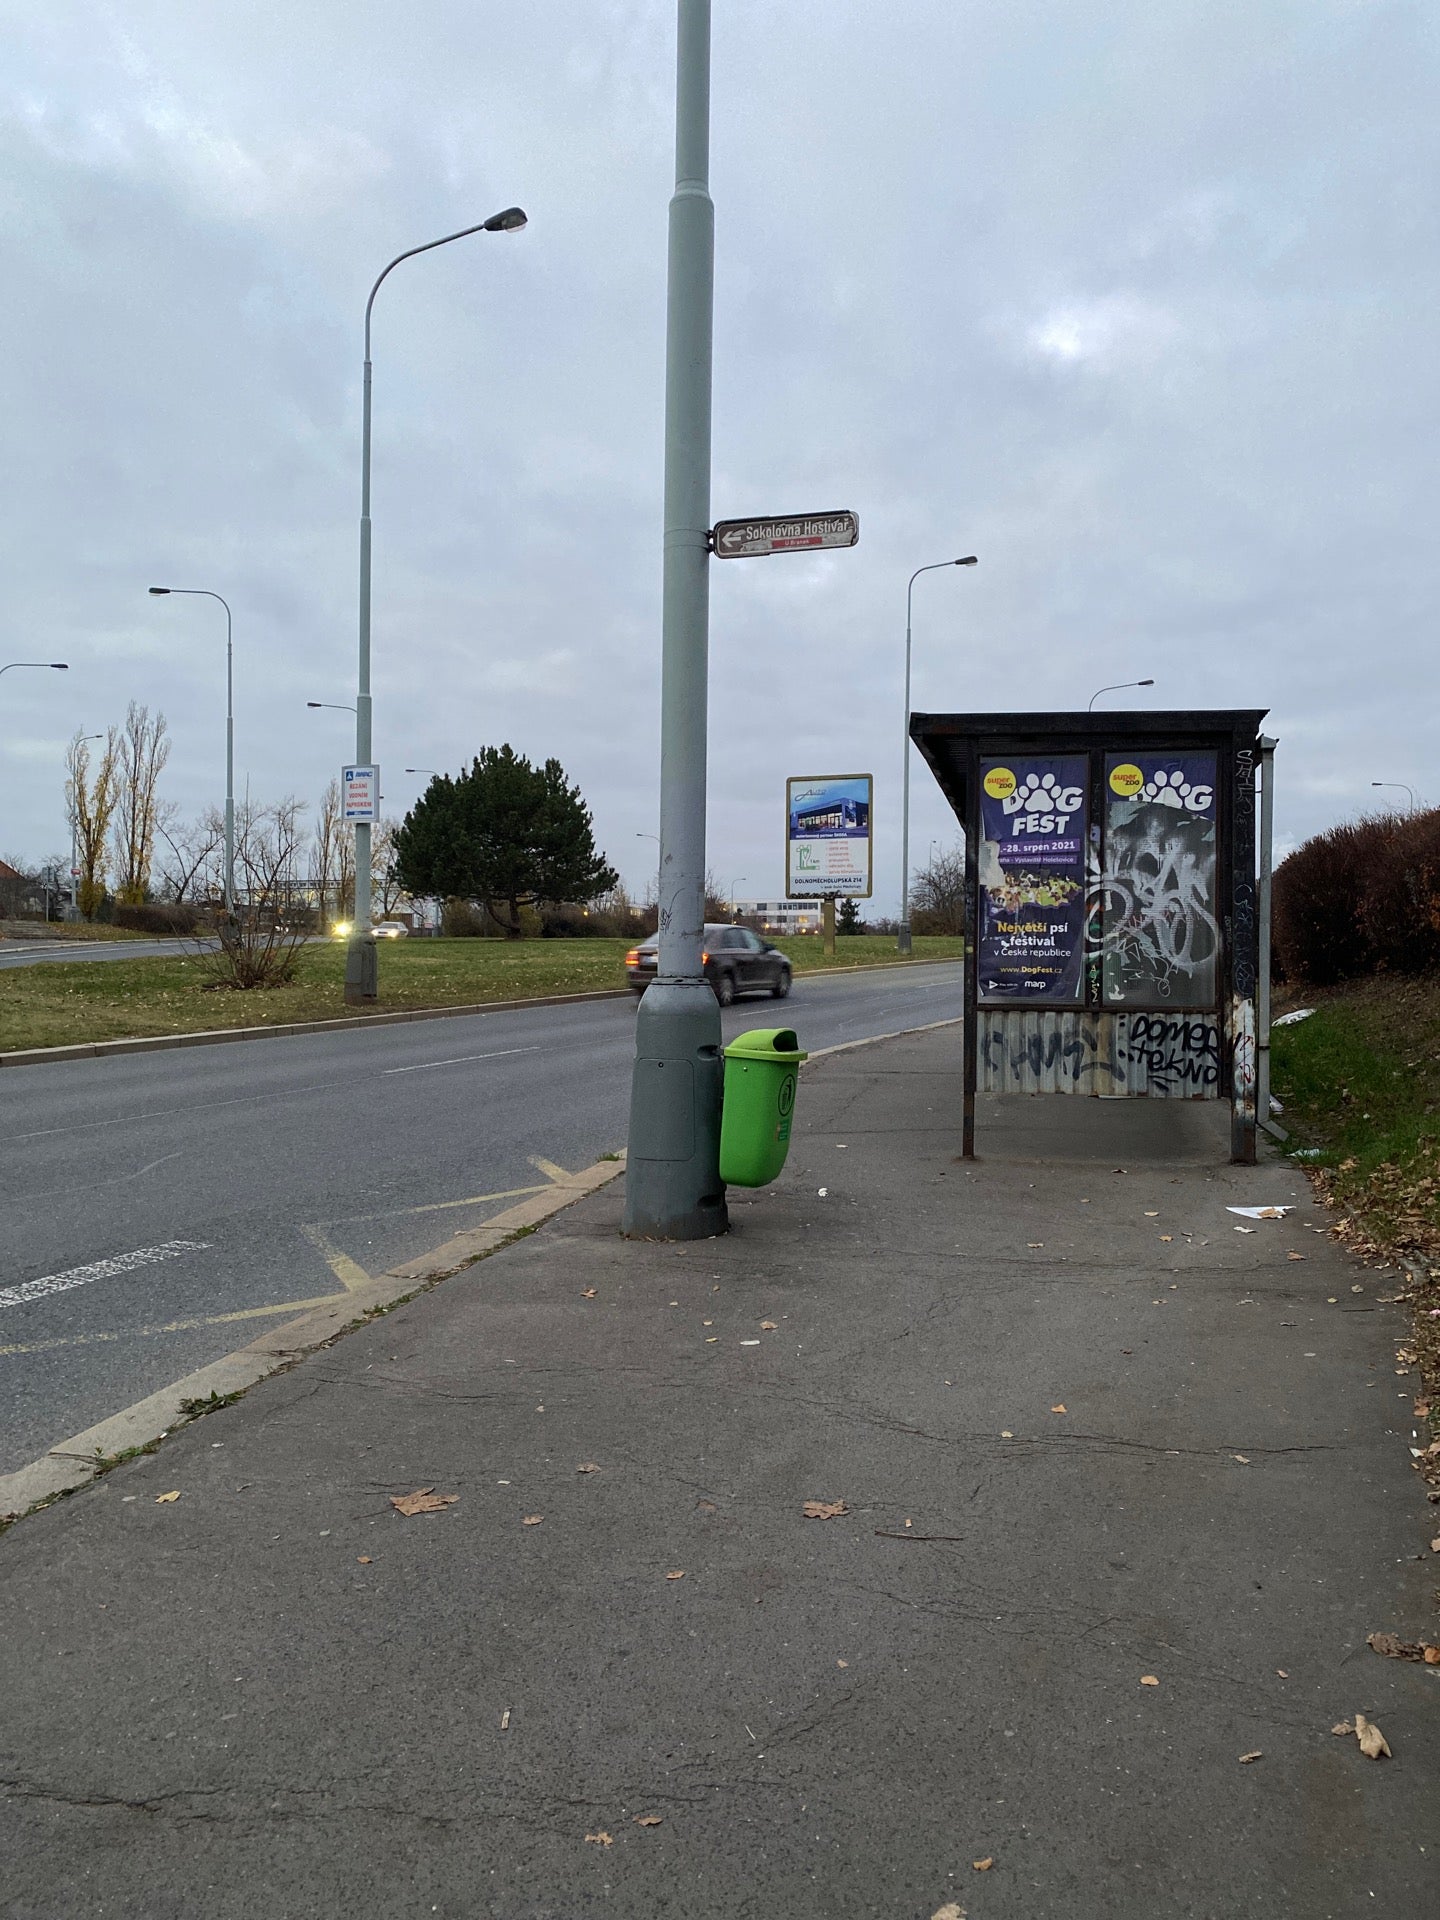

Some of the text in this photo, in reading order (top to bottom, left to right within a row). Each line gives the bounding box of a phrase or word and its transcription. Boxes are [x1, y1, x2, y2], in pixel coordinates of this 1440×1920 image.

[746, 518, 849, 541] Sokolovna Hostivař
[987, 777, 1010, 785] super
[1012, 813, 1070, 836] FEST
[1023, 842, 1050, 853] srpen
[1051, 841, 1075, 850] 2021
[997, 922, 1068, 934] Největší psí
[1009, 936, 1056, 946] festival
[1001, 947, 1028, 956] České
[1029, 948, 1072, 957] republice
[1000, 966, 1063, 975] www.DogFest.cz
[1024, 981, 1046, 989] marp
